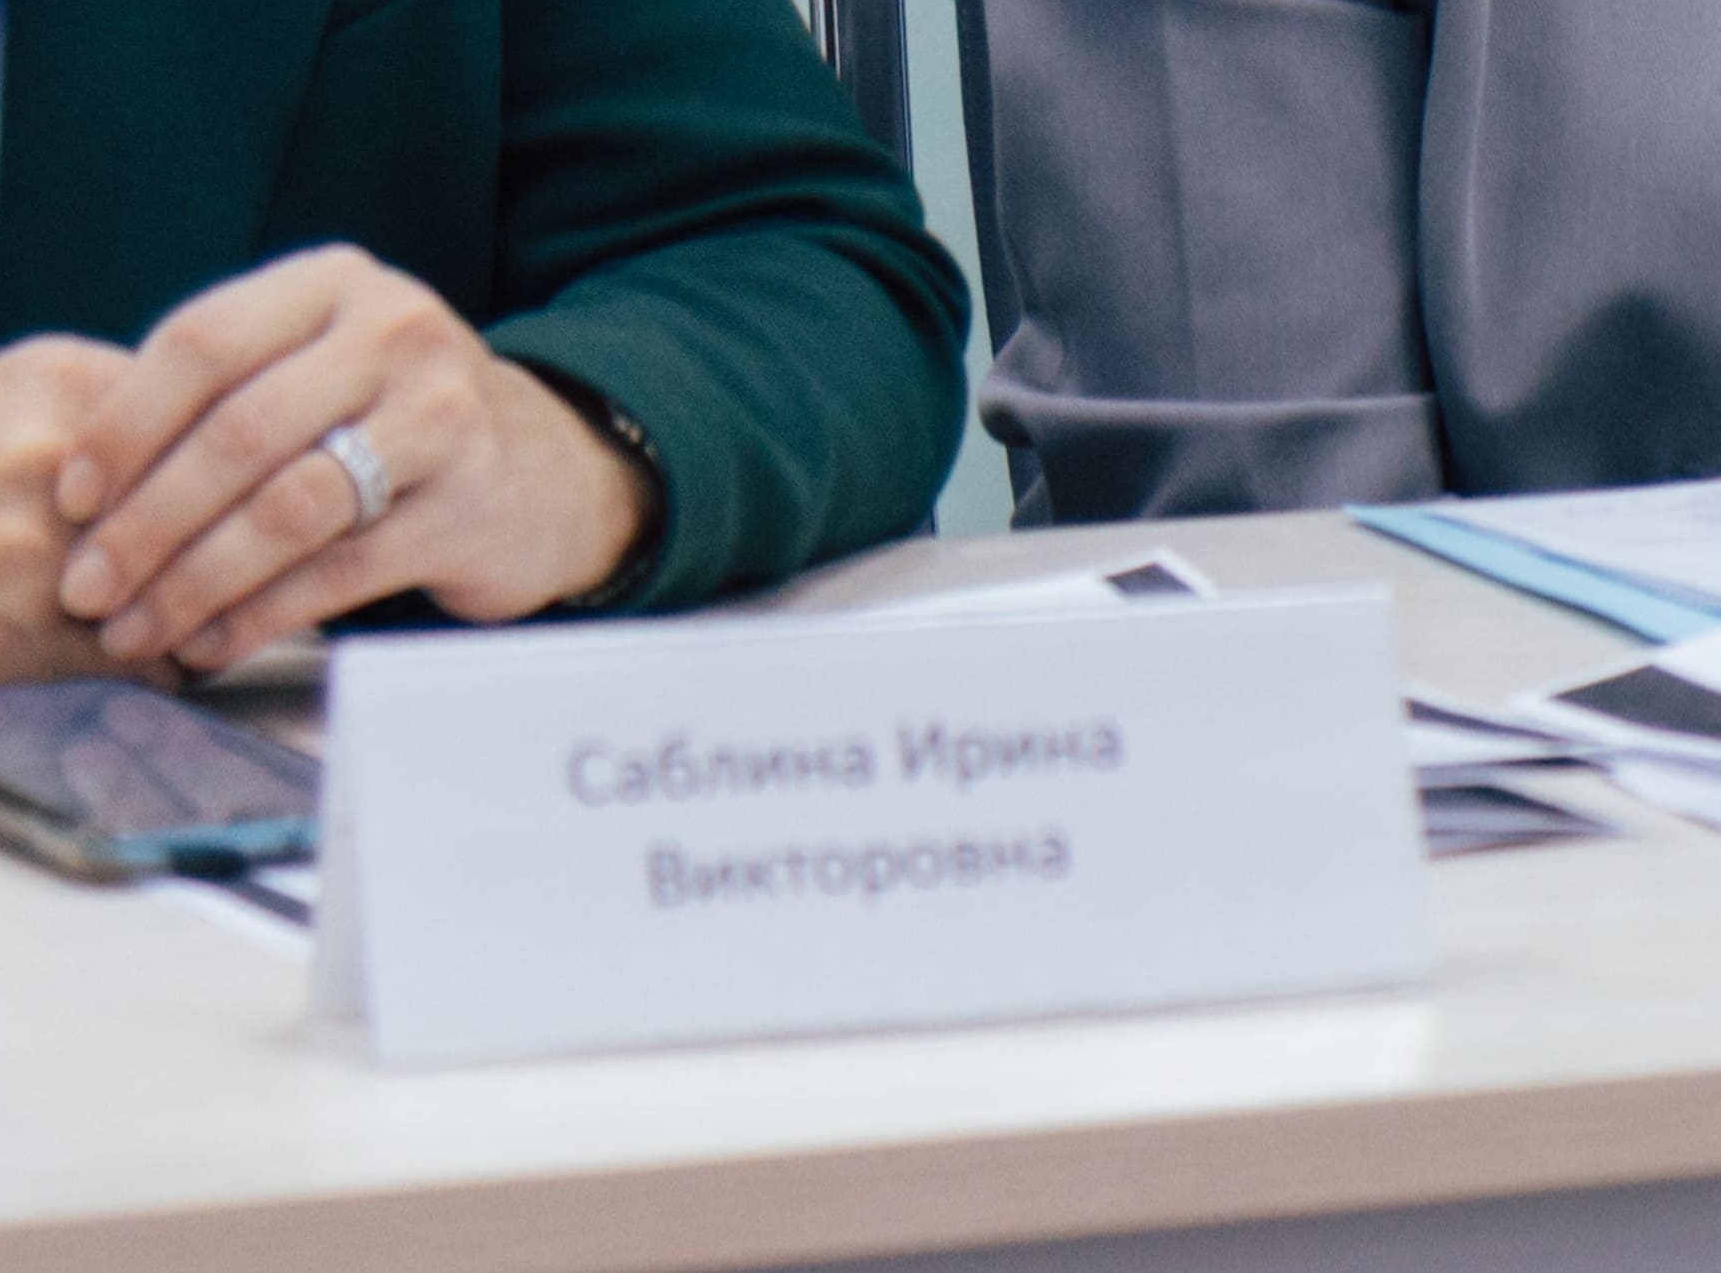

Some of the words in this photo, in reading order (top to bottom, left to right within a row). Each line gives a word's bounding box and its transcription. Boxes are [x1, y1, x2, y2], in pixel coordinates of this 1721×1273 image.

[566, 729, 876, 806] Саблина
[895, 716, 1126, 786] Ирина
[645, 827, 1073, 910] Викторовна
